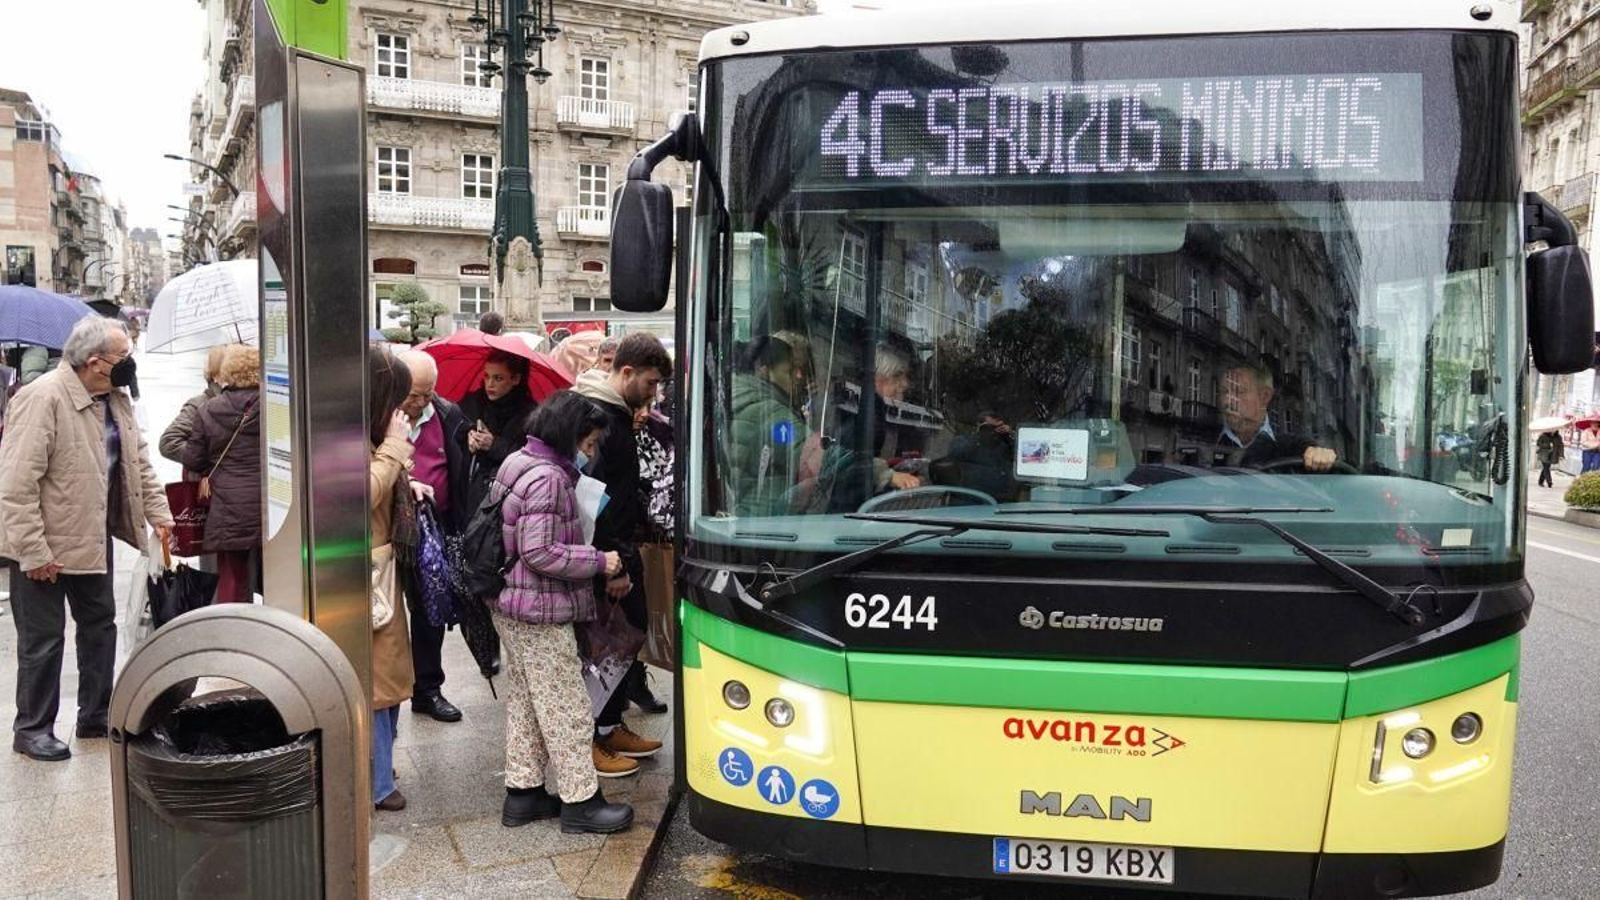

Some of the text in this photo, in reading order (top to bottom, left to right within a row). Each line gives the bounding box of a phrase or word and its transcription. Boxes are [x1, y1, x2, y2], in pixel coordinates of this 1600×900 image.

[821, 77, 1382, 177] 4C SERVIZOS MINIMOS
[844, 592, 938, 631] 6244
[1049, 611, 1164, 632] Castrosua
[1003, 717, 1146, 747] avanza
[1020, 789, 1153, 822] MAN
[1015, 843, 1165, 879] 0319 KBX
